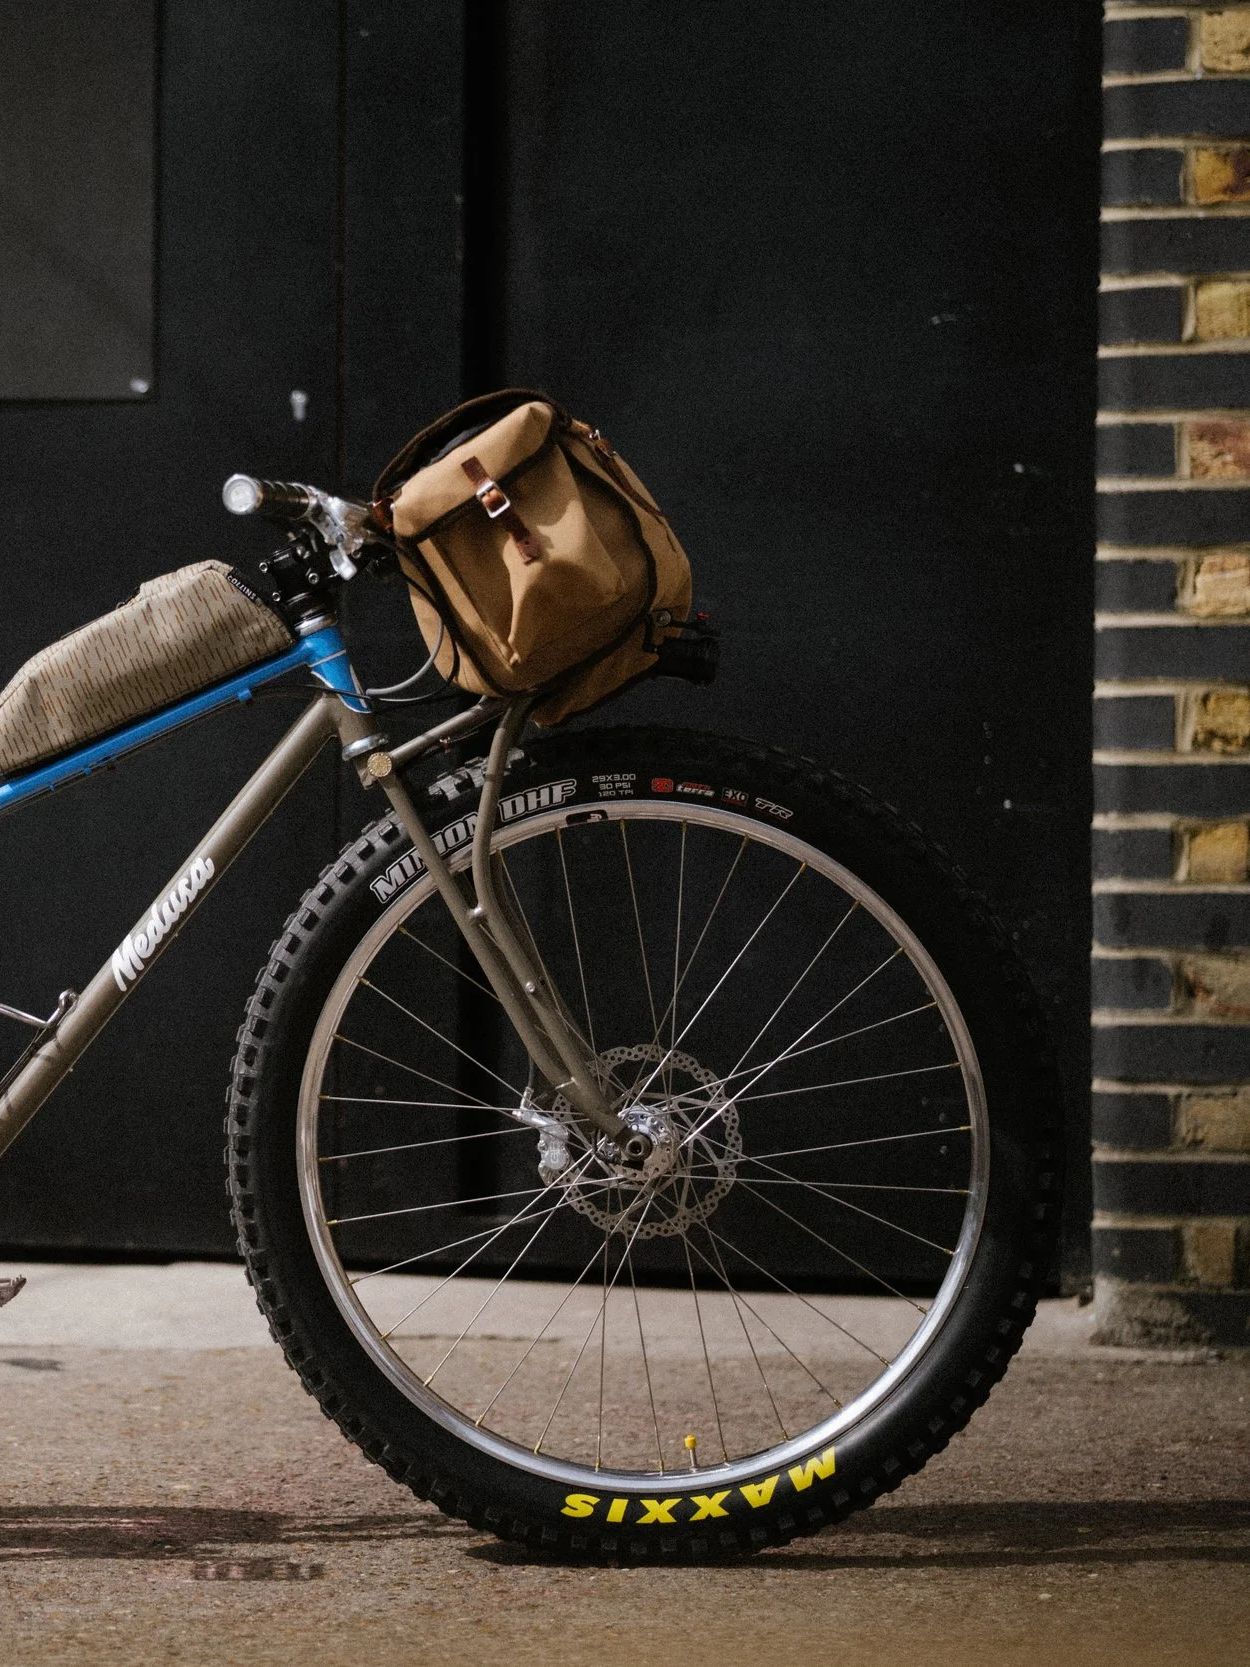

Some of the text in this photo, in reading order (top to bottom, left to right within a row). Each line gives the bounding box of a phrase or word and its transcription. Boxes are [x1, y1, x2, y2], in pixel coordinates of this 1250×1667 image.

[227, 574, 257, 600] COLLINS
[498, 778, 577, 823] DHF
[615, 781, 631, 790] PSI
[755, 797, 794, 820] TR
[112, 857, 215, 992] Medusa
[560, 1446, 837, 1525] MAXXIS
